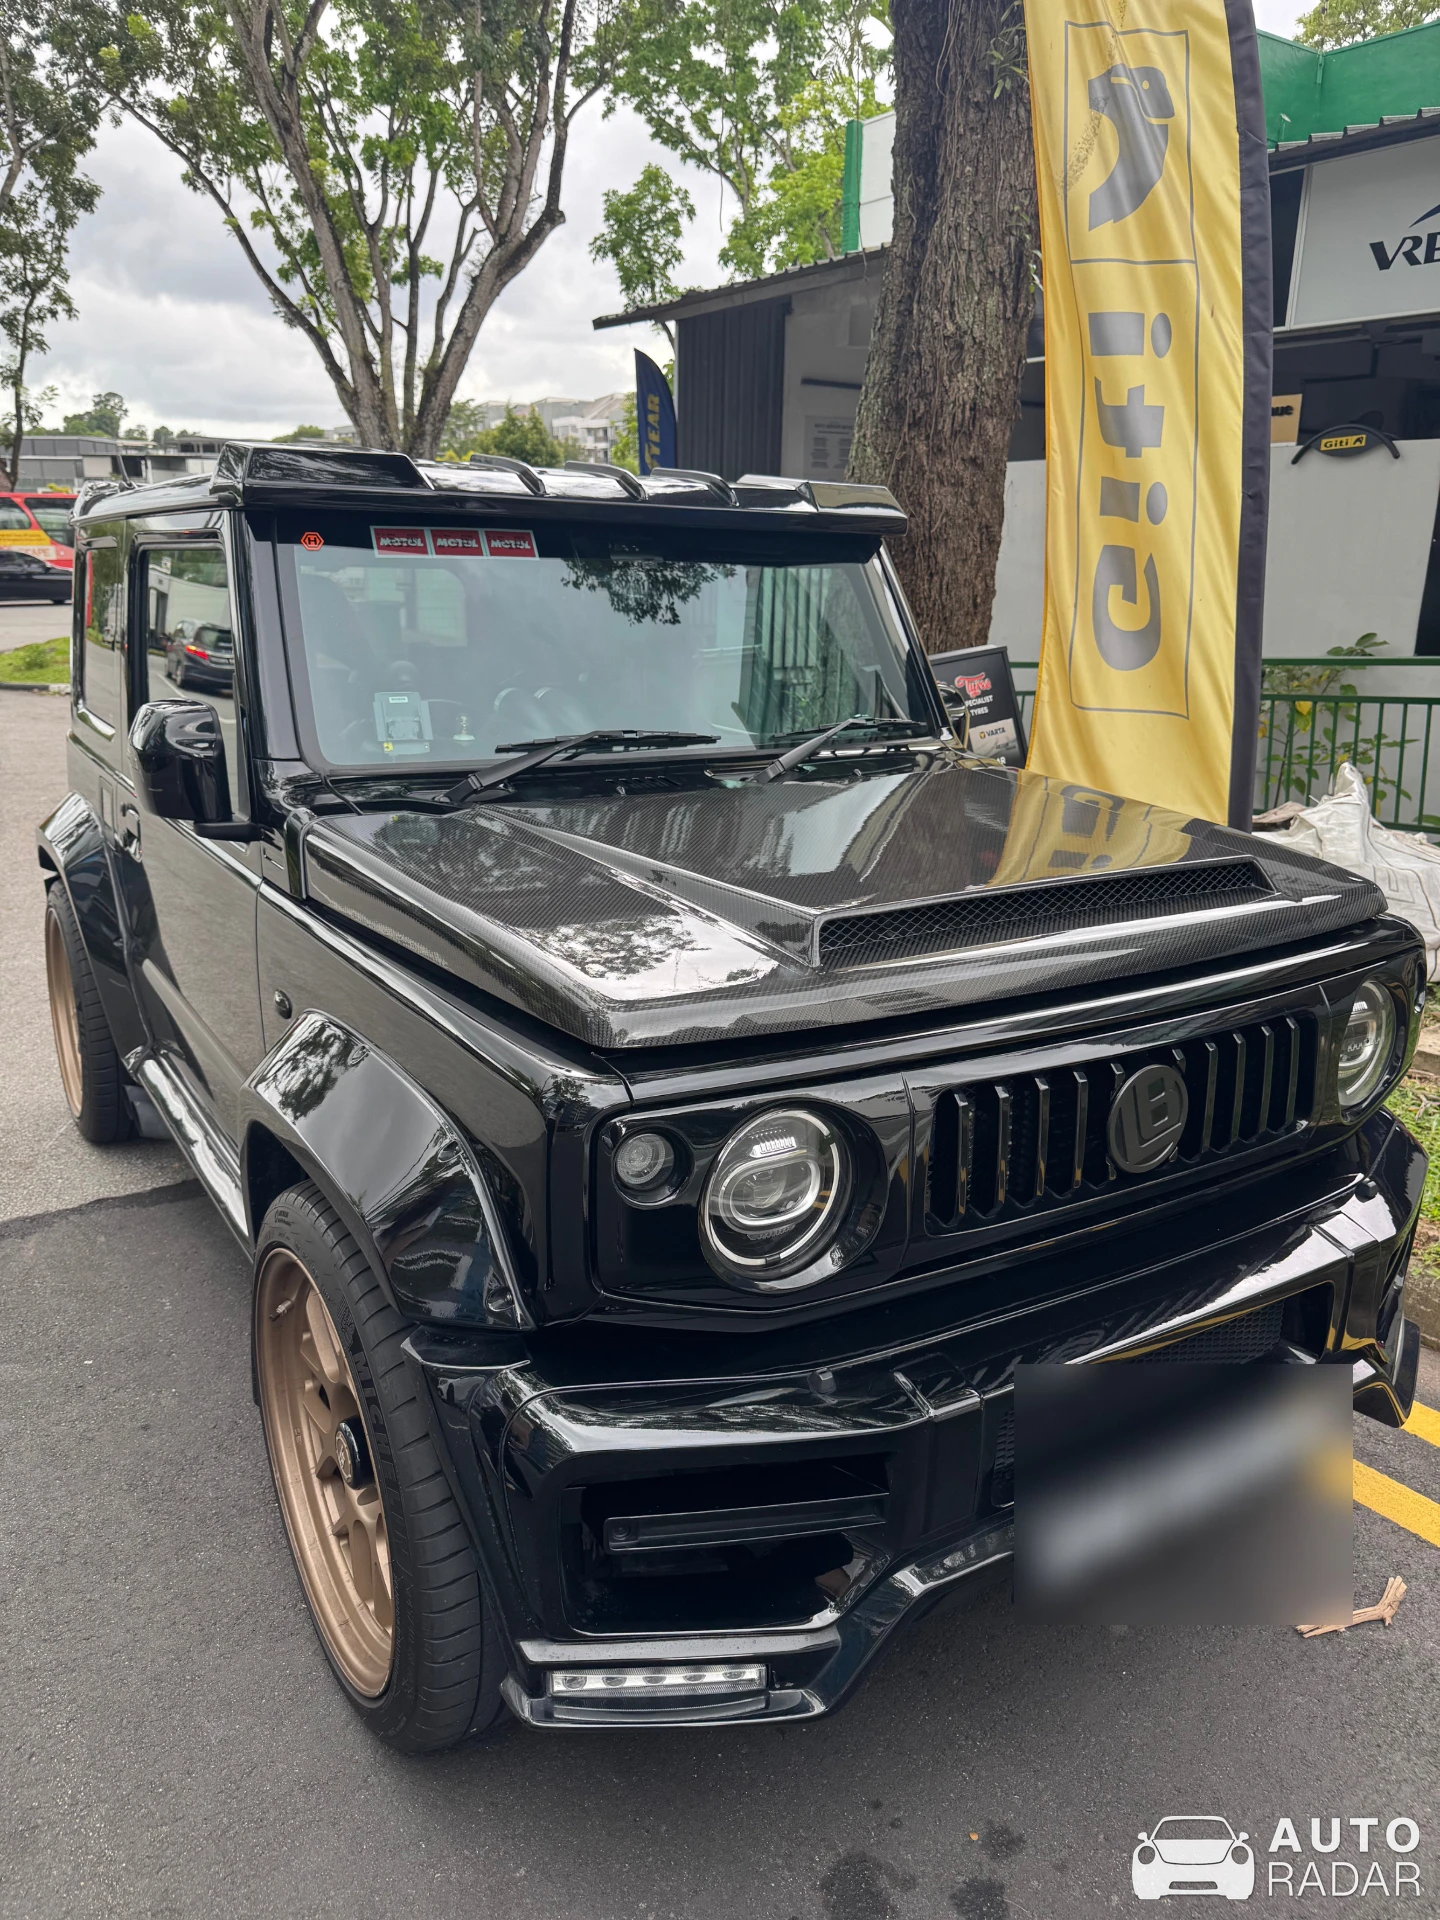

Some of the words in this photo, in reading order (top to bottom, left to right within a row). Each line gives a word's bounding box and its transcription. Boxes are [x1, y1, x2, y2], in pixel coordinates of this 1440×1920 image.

[1323, 438, 1349, 449] Giti
[1088, 312, 1172, 671] Giti
[379, 536, 424, 547] MOTUL
[436, 538, 479, 548] MOTUL
[490, 539, 531, 549] MOTUL
[965, 695, 994, 708] PECIALIST
[970, 707, 990, 717] TYRES
[986, 727, 1006, 737] VARTA
